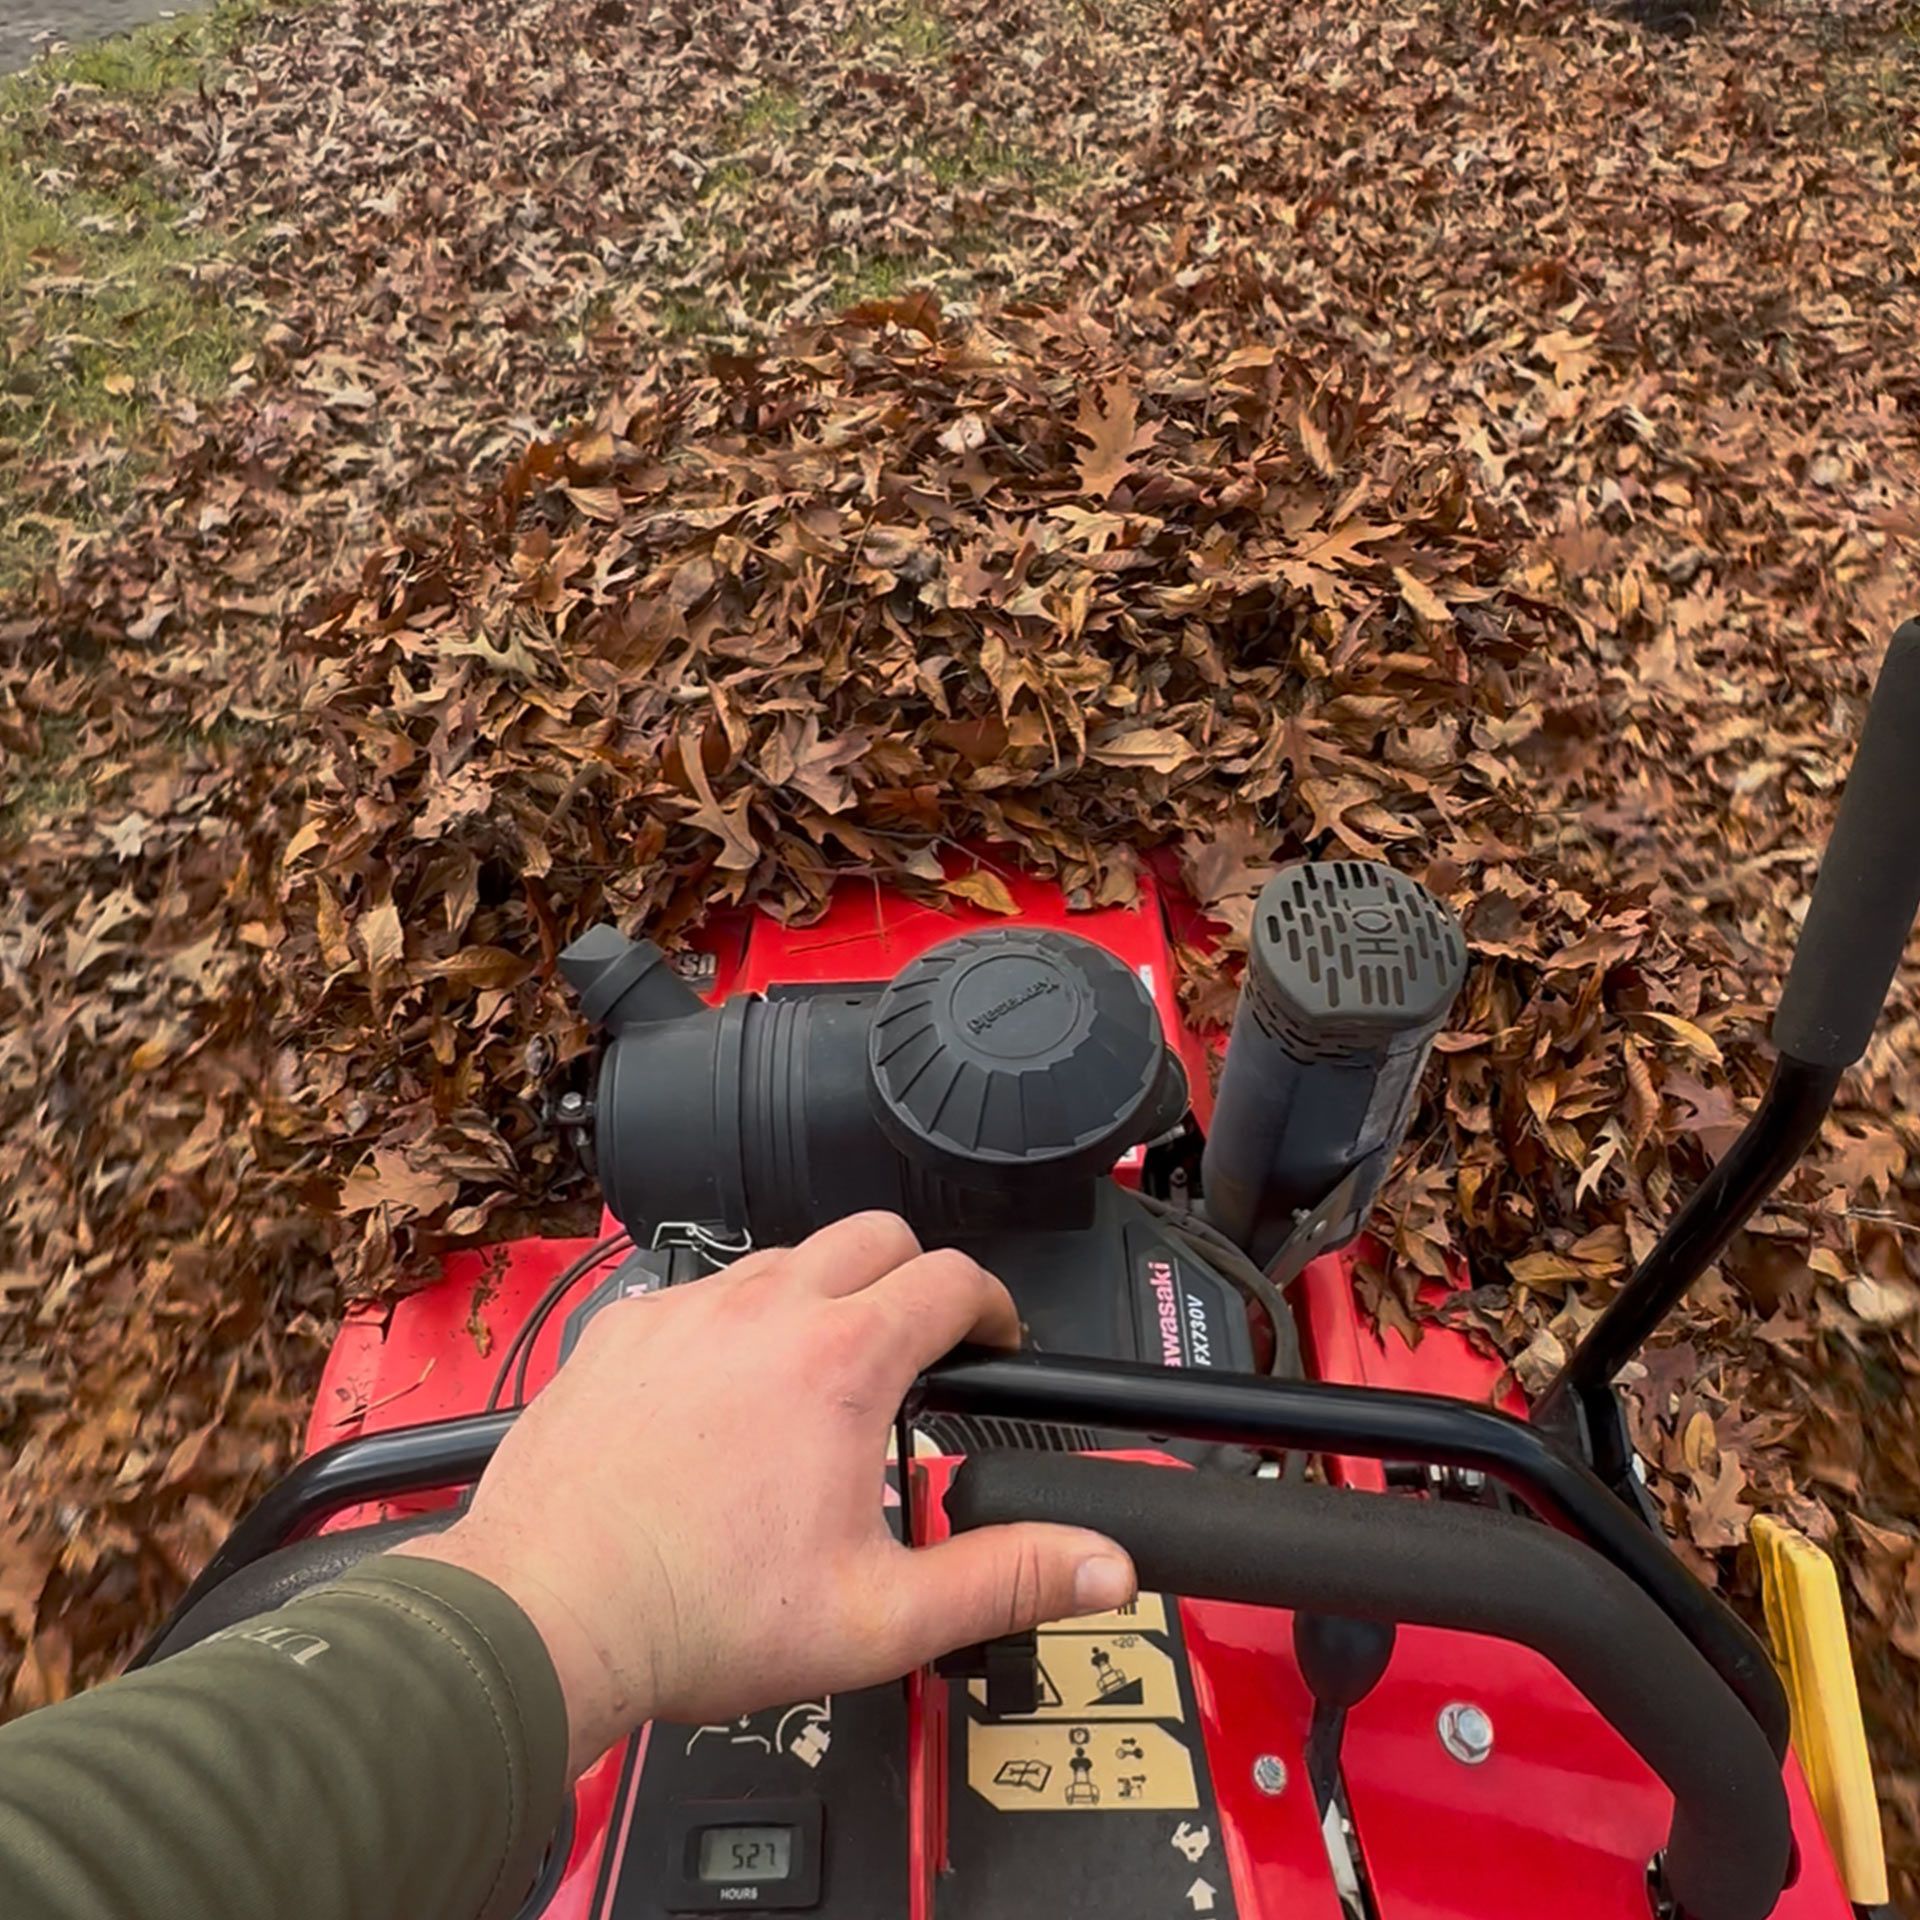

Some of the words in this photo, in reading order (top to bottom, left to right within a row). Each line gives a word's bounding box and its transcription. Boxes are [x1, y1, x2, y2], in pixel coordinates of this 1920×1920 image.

[1148, 1261, 1183, 1368] awasaki
[1186, 1293, 1212, 1367] FX730V
[731, 1842, 777, 1871] 527
[720, 1887, 759, 1901] HOURS
